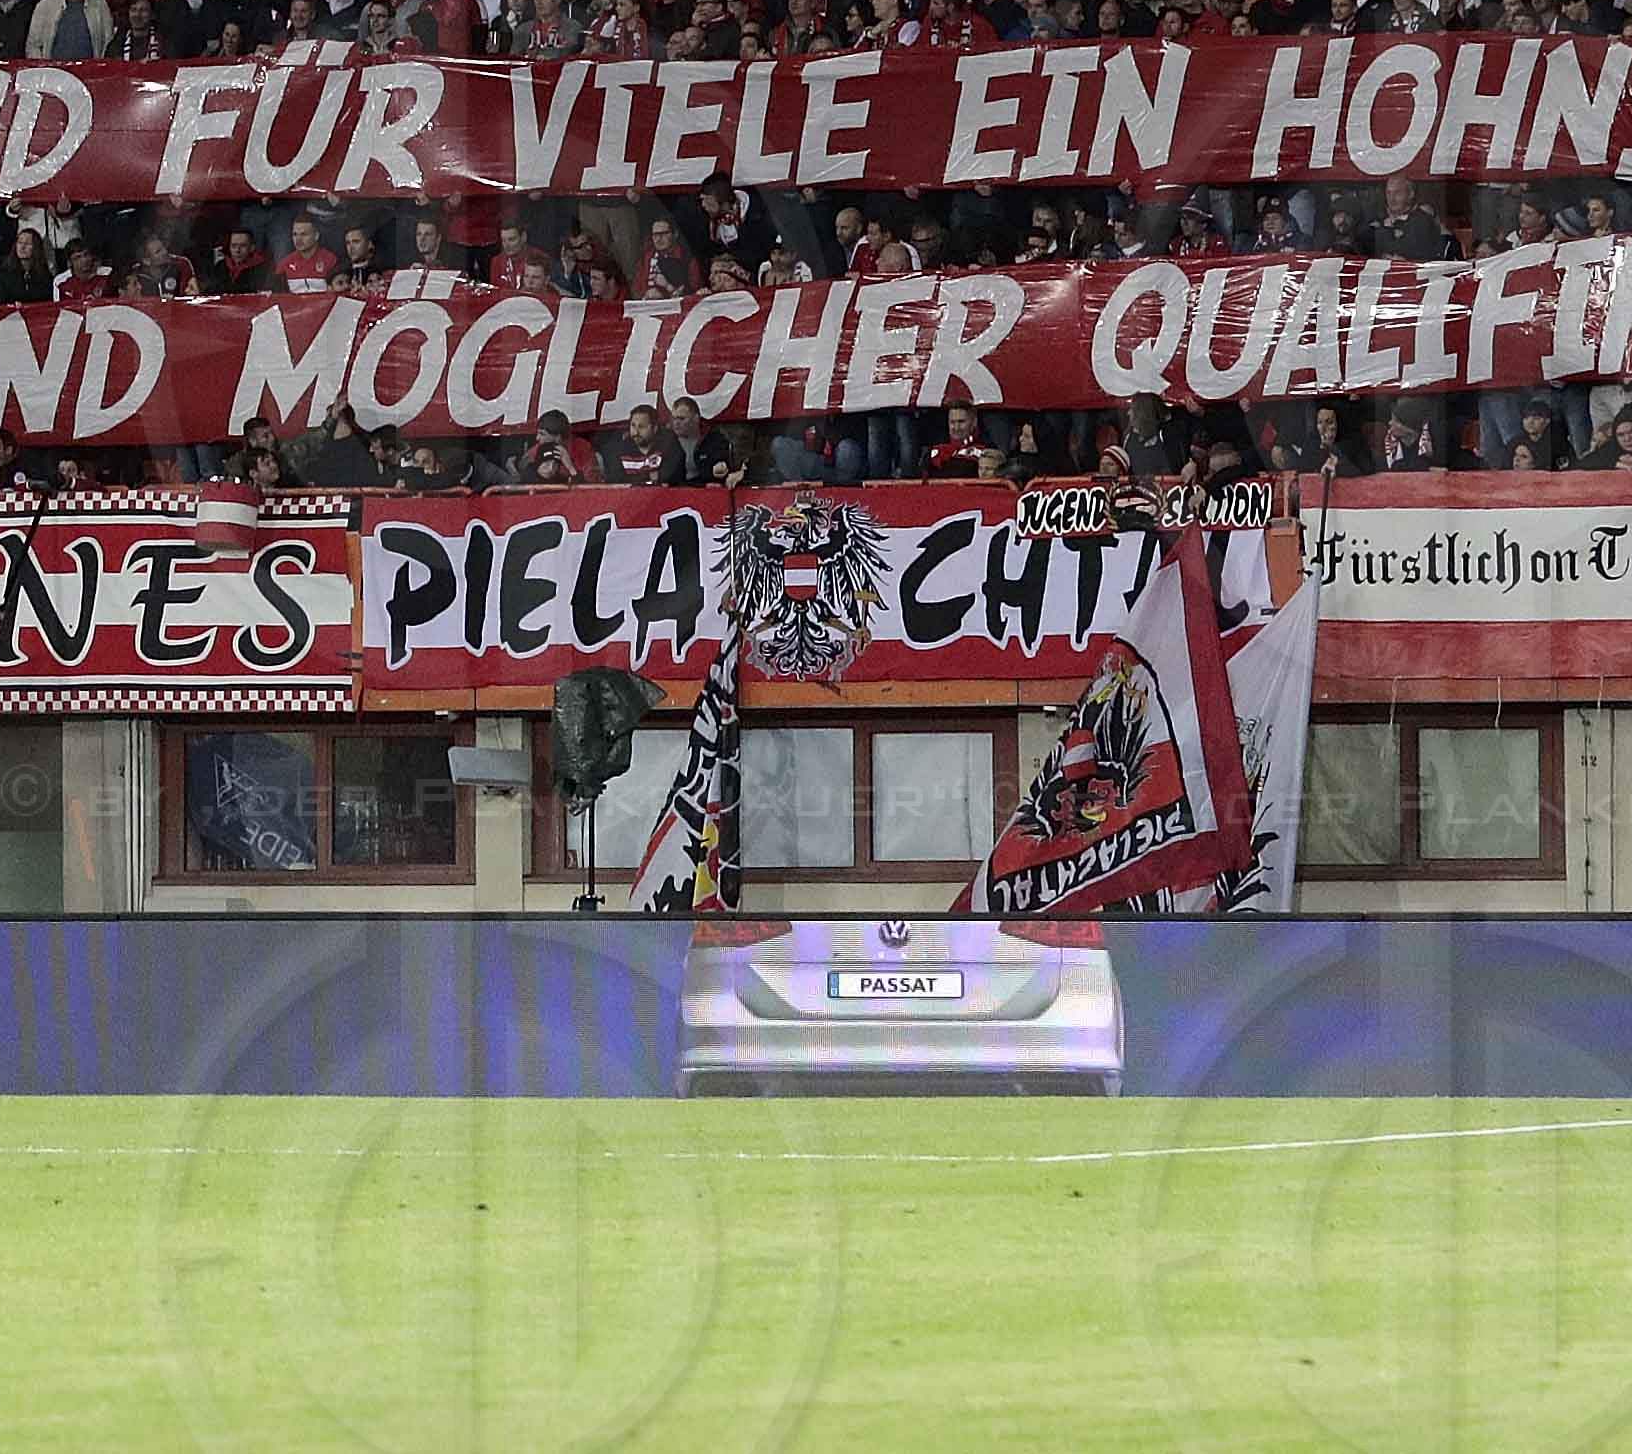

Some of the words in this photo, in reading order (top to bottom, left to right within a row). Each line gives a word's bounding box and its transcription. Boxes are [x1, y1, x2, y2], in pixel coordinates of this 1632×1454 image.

[155, 40, 444, 195] FÜR
[511, 50, 883, 191] VIELE
[943, 42, 1192, 184] EIN
[227, 268, 1027, 440] MÖGLICHER
[1016, 487, 1107, 535] JUGEND
[1160, 482, 1272, 527] SETION
[1529, 552, 1580, 582] on
[859, 976, 939, 993] PASSAT
